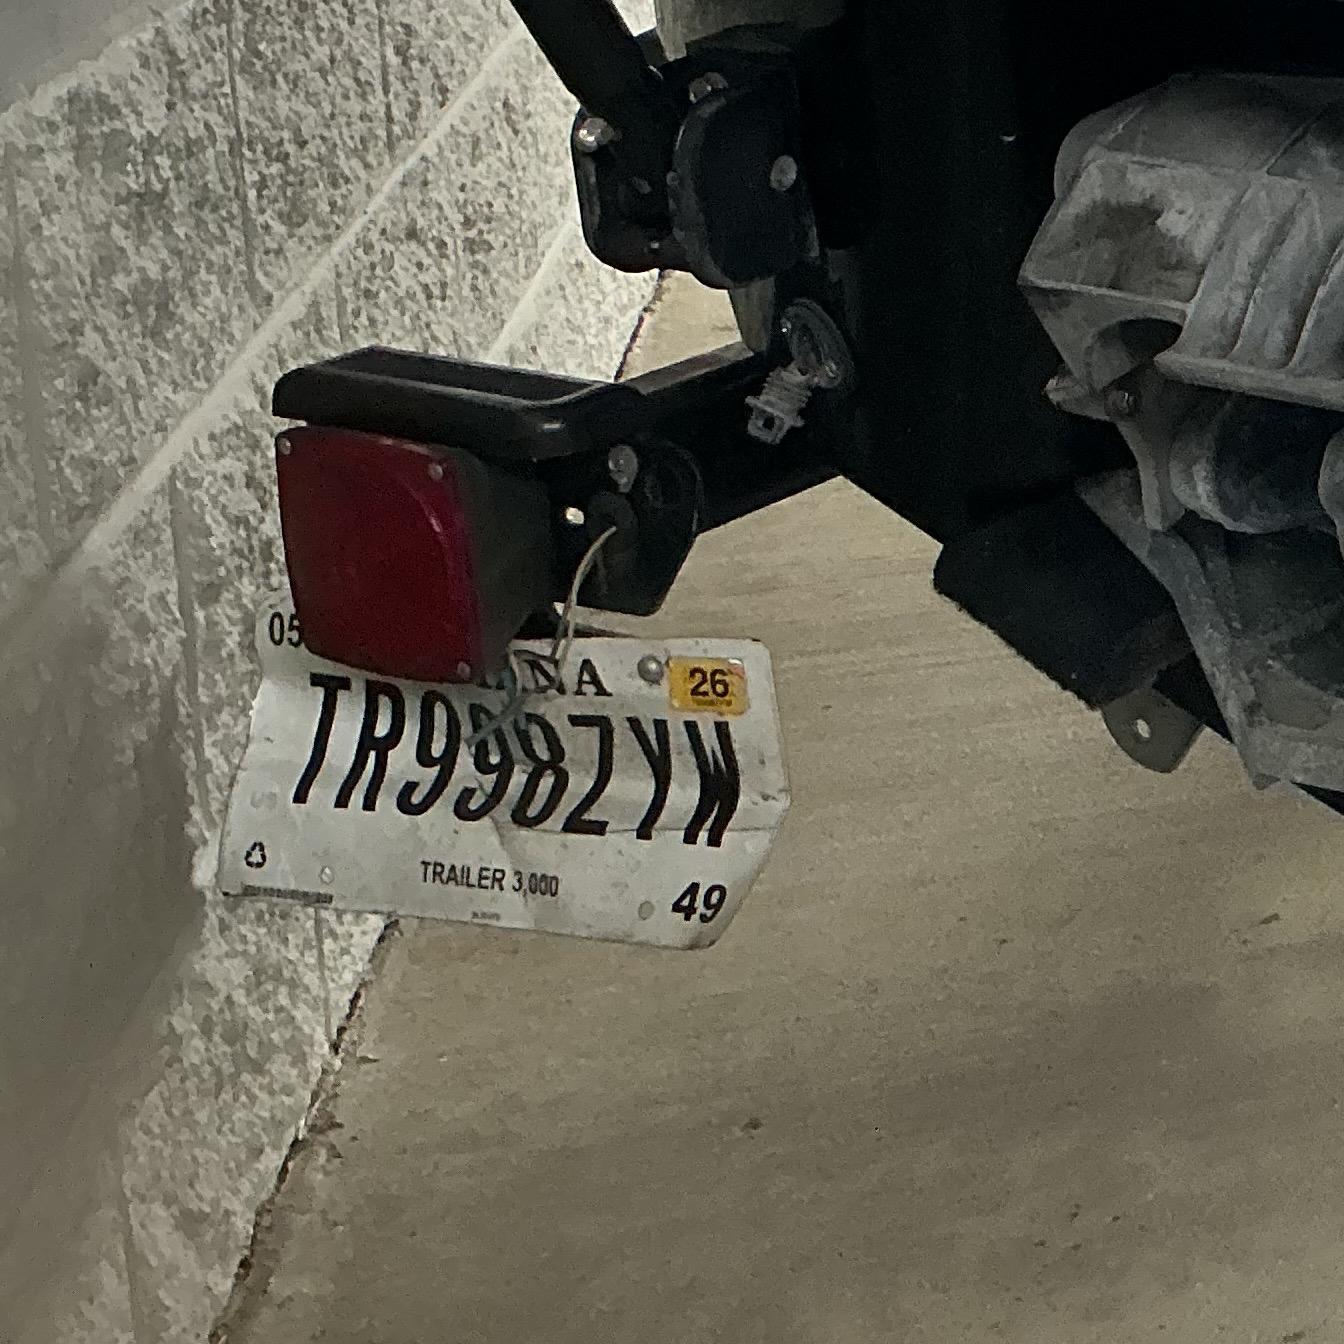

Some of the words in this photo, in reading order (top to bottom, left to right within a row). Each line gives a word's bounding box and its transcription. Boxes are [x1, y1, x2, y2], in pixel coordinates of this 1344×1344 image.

[269, 611, 304, 648] 05
[688, 666, 731, 699] 26
[420, 860, 506, 892] TRAILER
[511, 867, 560, 898] 3,000
[671, 882, 727, 925] 49
